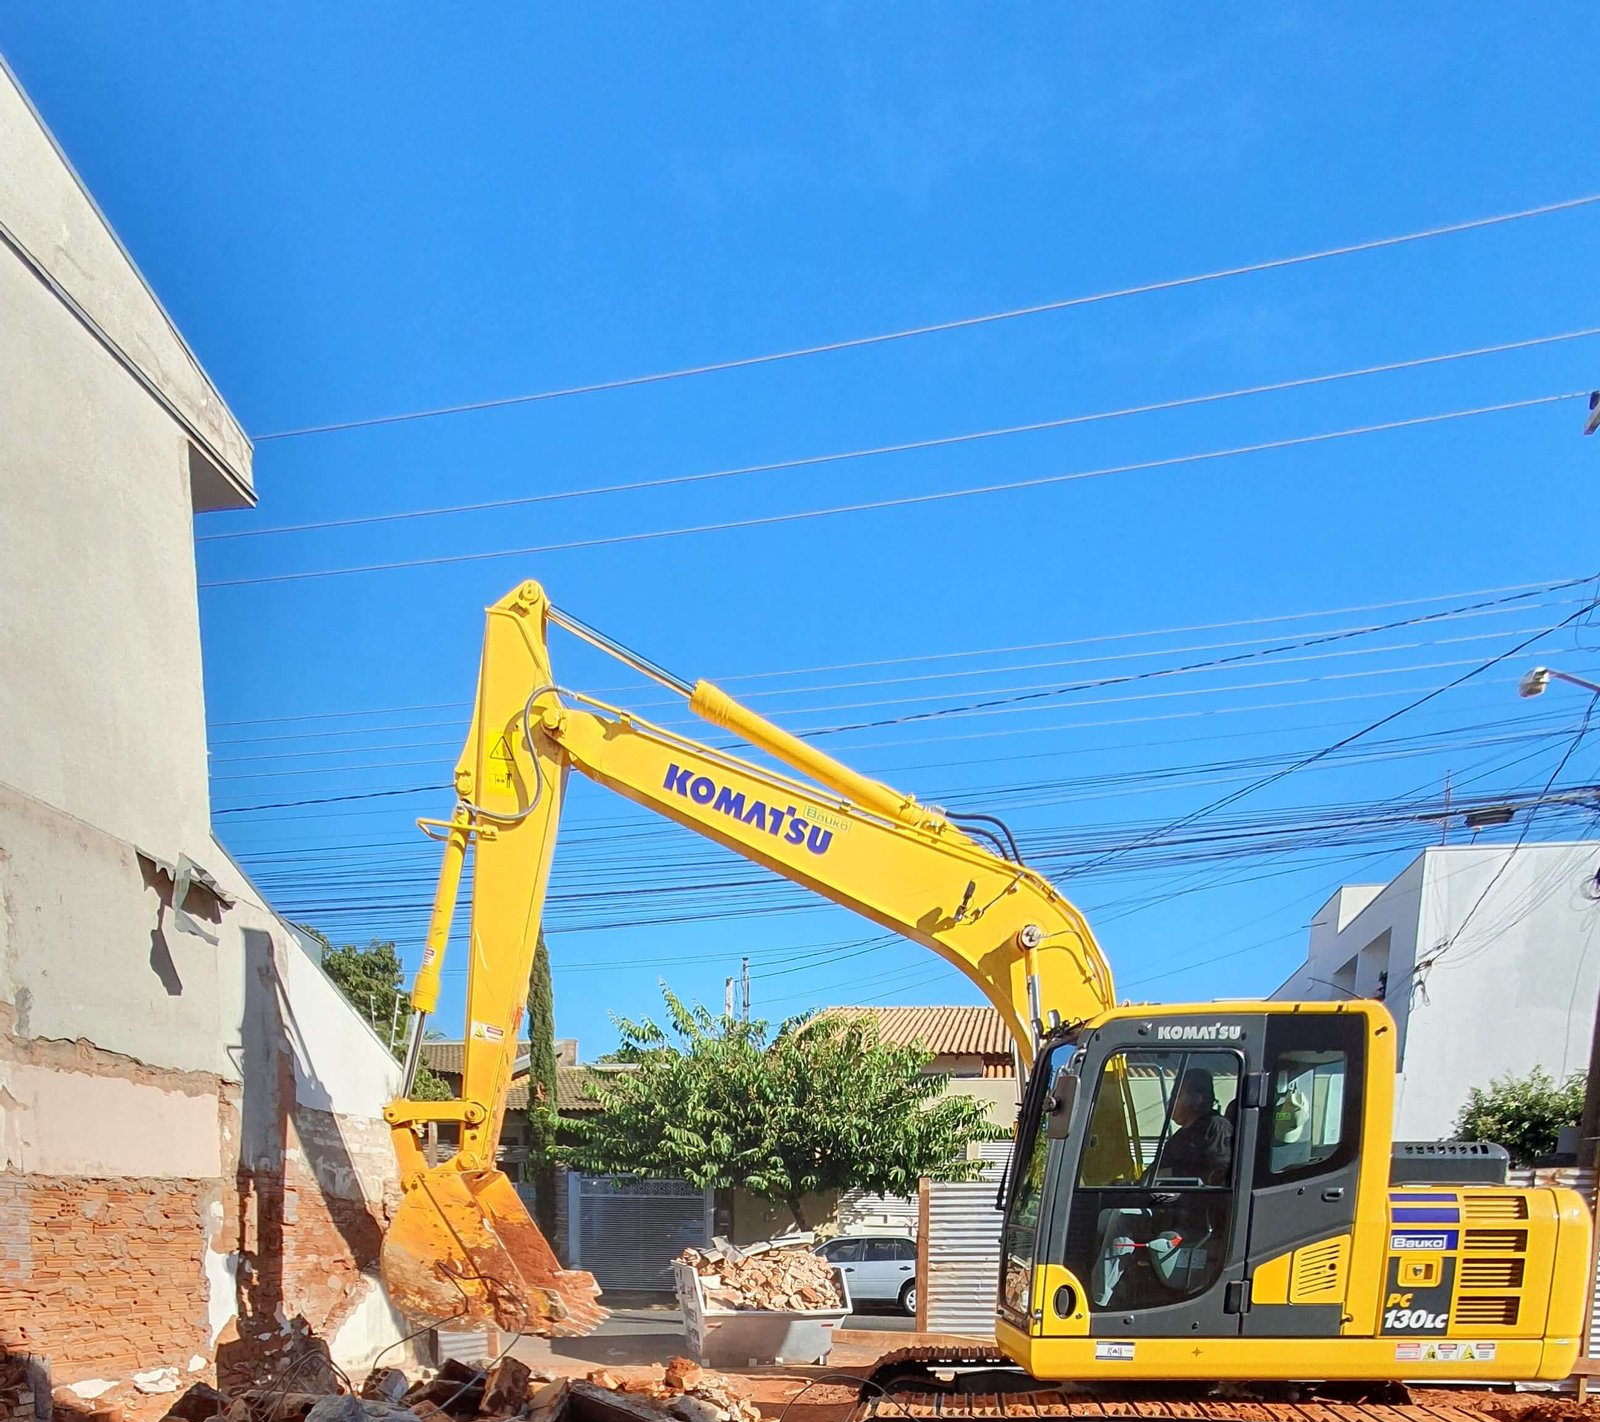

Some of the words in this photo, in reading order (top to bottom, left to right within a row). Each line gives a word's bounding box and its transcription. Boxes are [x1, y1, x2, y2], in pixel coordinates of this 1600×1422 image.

[663, 763, 833, 855] KOMATSU
[1157, 1022, 1242, 1040] KOMATSU
[1393, 1237, 1443, 1248] Bauko
[1386, 1293, 1414, 1308] PC
[1384, 1309, 1449, 1329] 130LC
